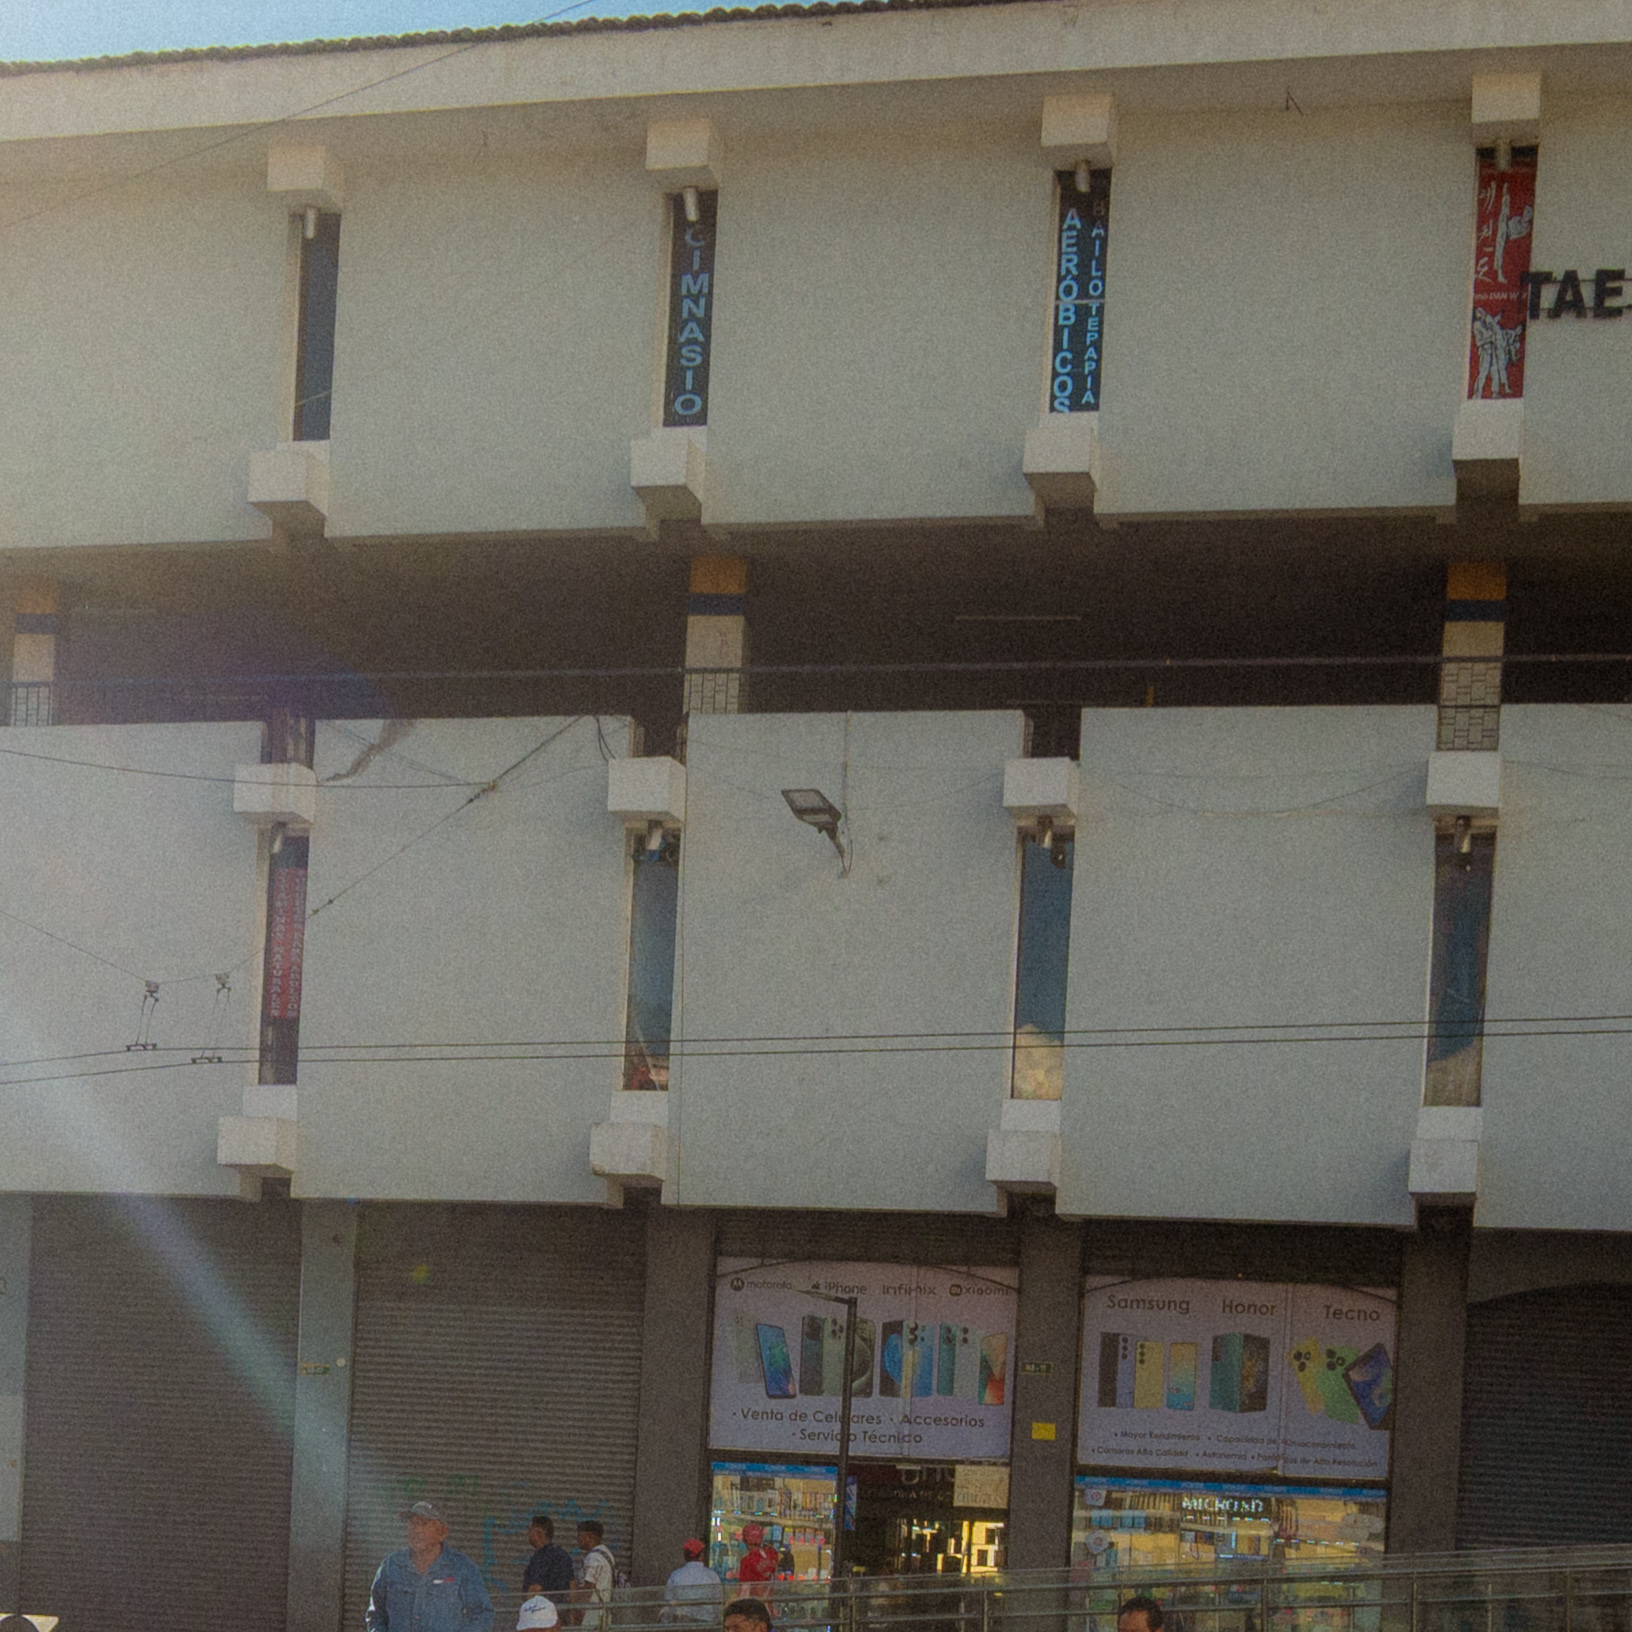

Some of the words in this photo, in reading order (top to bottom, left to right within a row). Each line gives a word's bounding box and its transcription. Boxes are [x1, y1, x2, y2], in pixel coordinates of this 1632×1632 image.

[1520, 268, 1626, 321] TAE
[1107, 1294, 1190, 1315] Samsung
[1222, 1298, 1277, 1316] Honor
[1323, 1304, 1380, 1322] Tecno
[741, 1408, 784, 1422] Venta
[789, 1409, 808, 1423] de
[812, 1409, 882, 1425] Celuares
[900, 1413, 986, 1429] Accesorios
[799, 1429, 858, 1443] Servico
